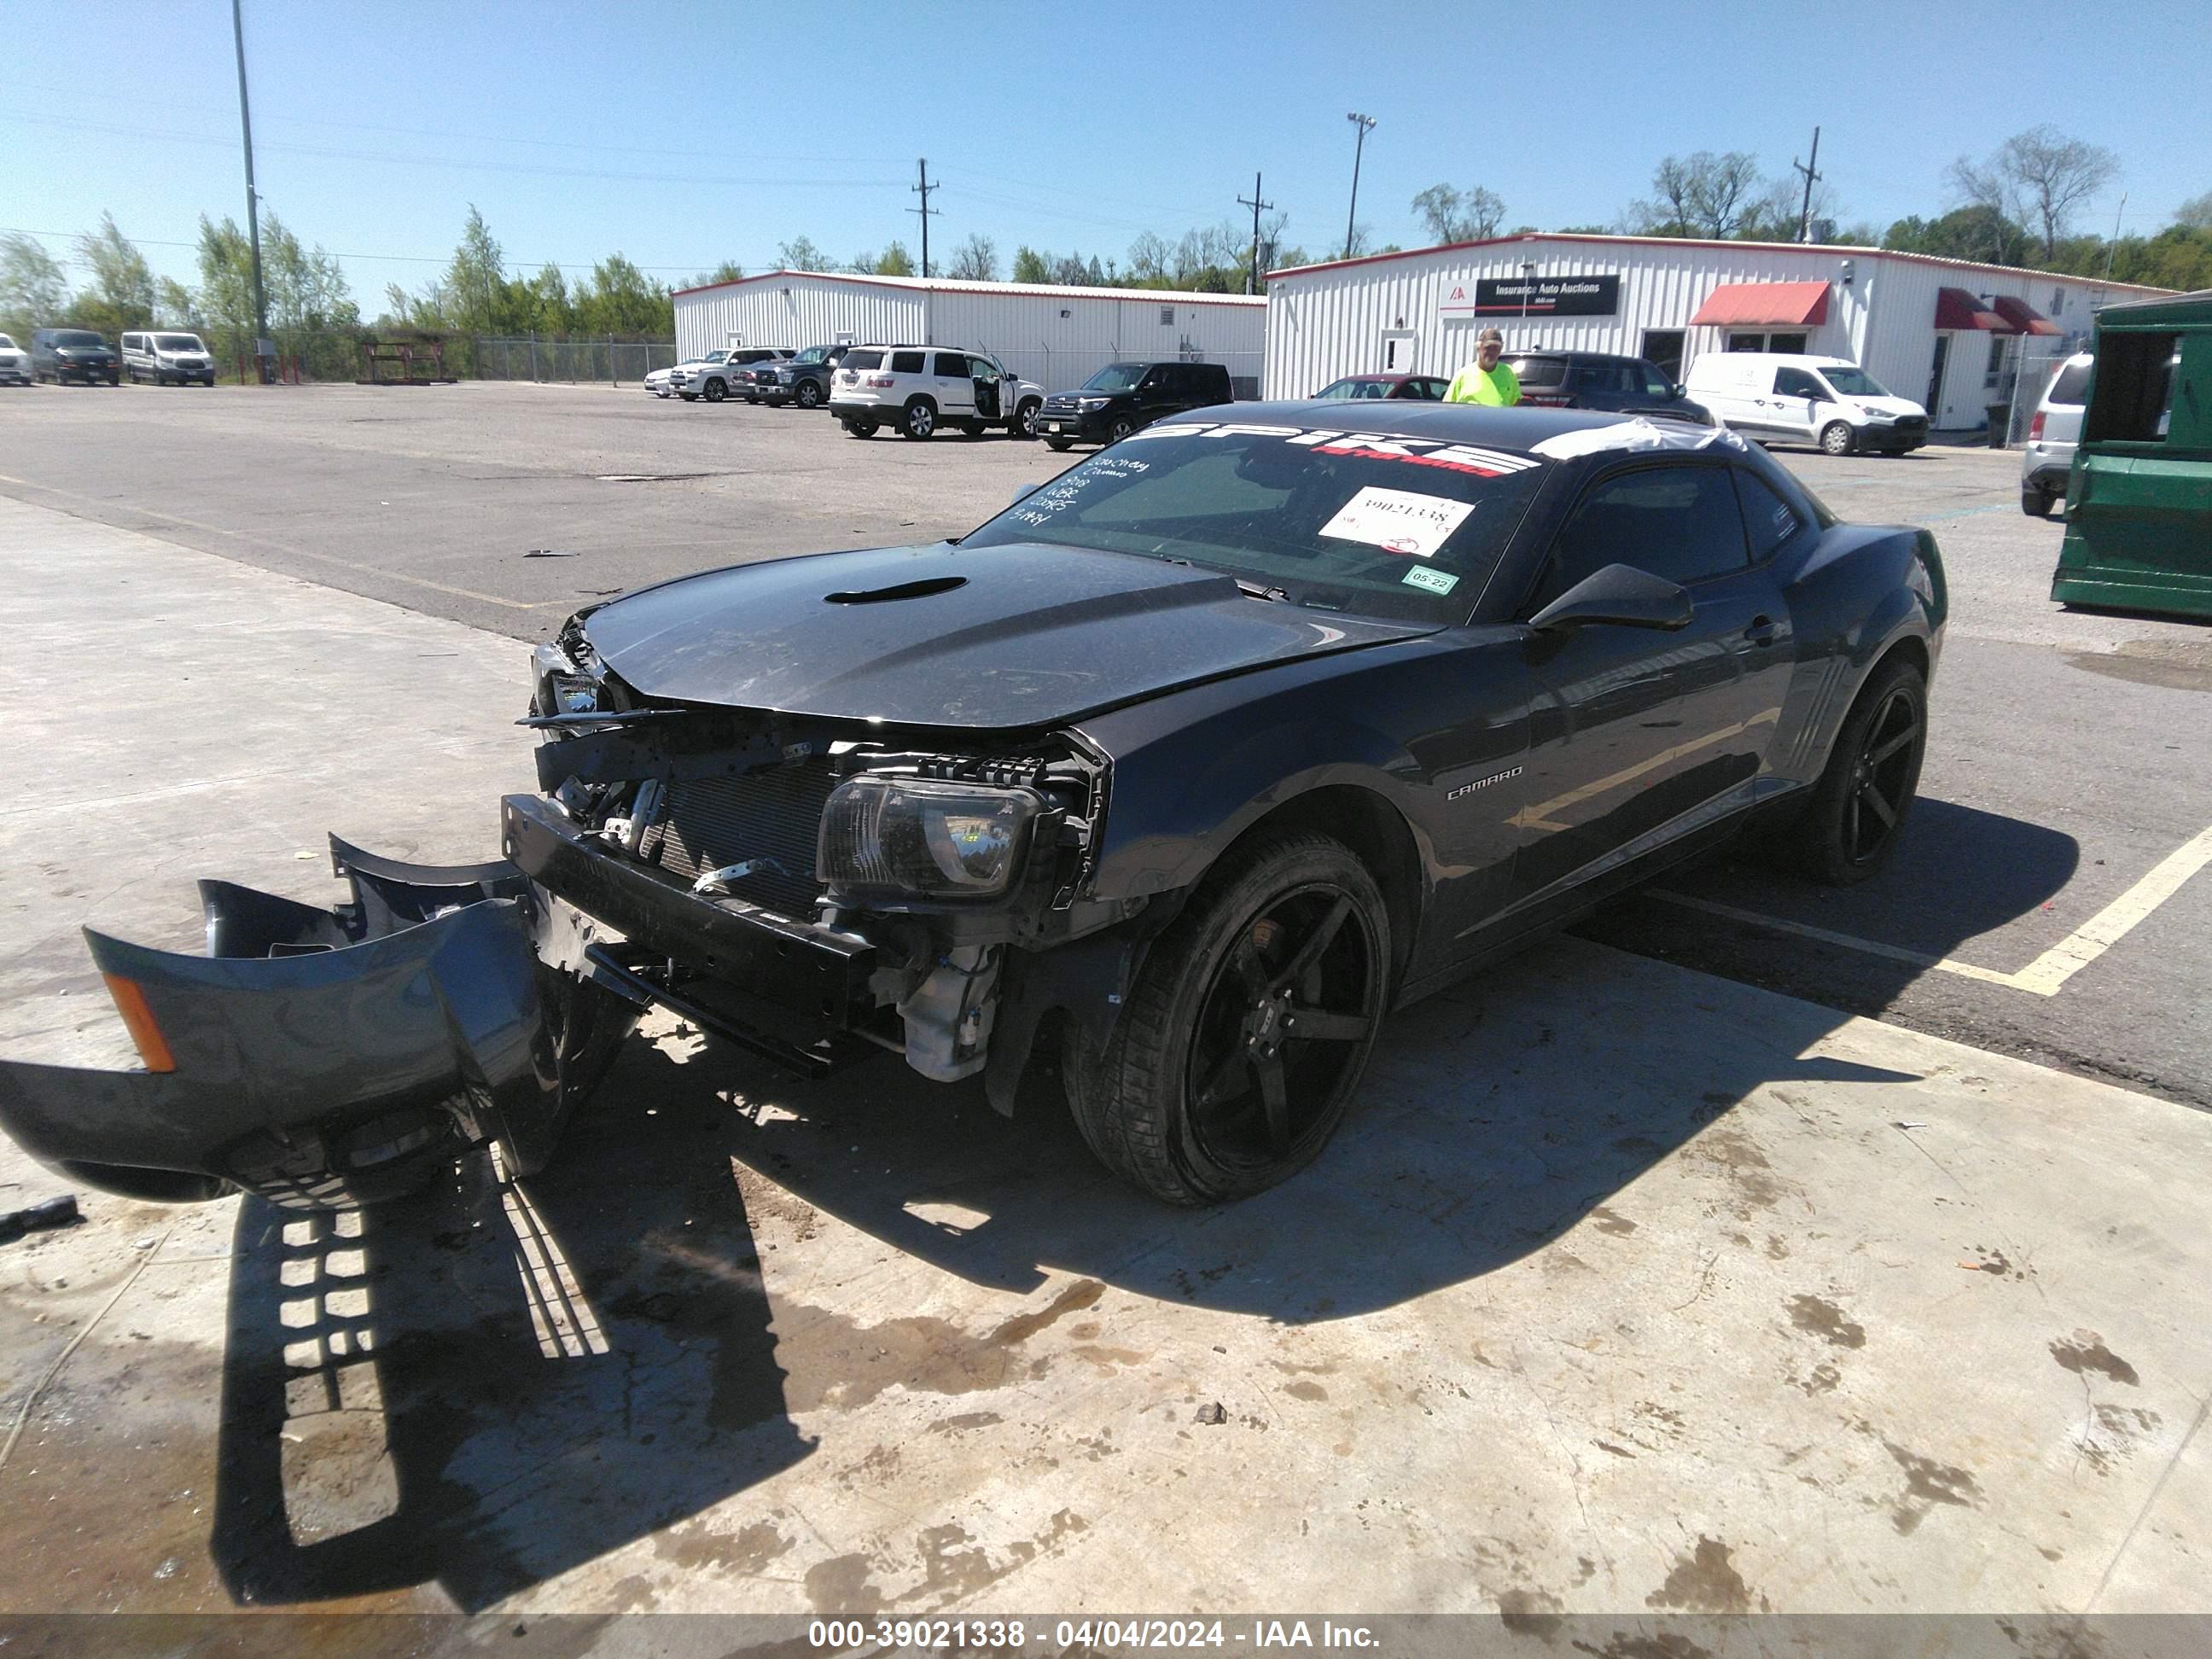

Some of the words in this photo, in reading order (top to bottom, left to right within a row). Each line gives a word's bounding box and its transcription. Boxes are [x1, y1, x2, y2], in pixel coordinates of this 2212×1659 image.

[1495, 284, 1536, 296] Insurance
[1539, 283, 1559, 294] Auto
[1560, 282, 1600, 294] Auctions
[1121, 423, 1542, 475] SPIKE
[1365, 499, 1450, 522] 39021338
[1447, 765, 1523, 800] CAMARO
